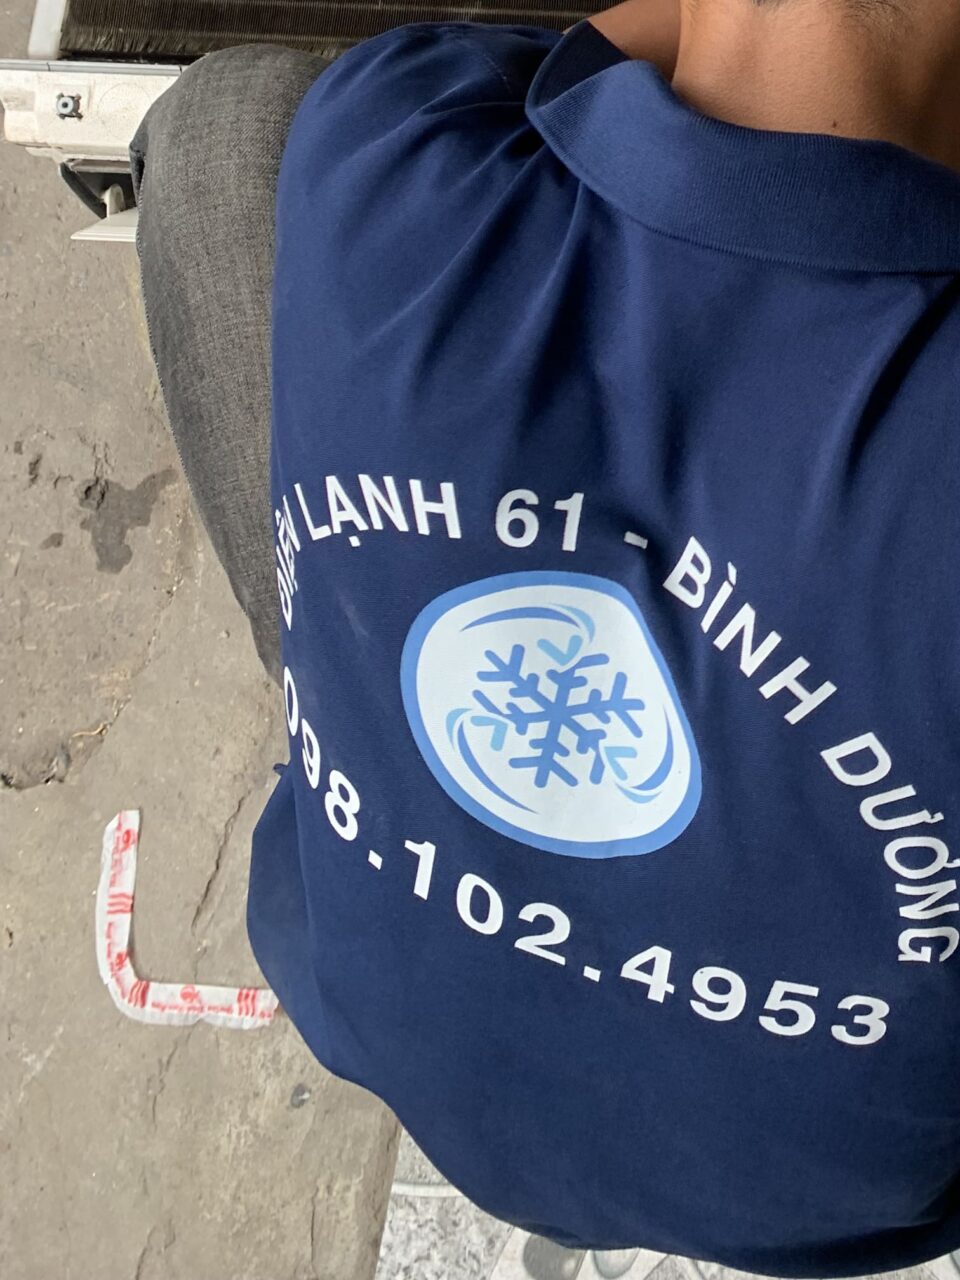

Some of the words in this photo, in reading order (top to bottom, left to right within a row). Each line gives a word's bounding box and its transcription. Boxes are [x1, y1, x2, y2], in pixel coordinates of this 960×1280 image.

[294, 474, 462, 548] LẠNH
[495, 489, 585, 552] 61
[662, 535, 838, 725] BÌNH
[284, 666, 890, 1046] 098.102.4953
